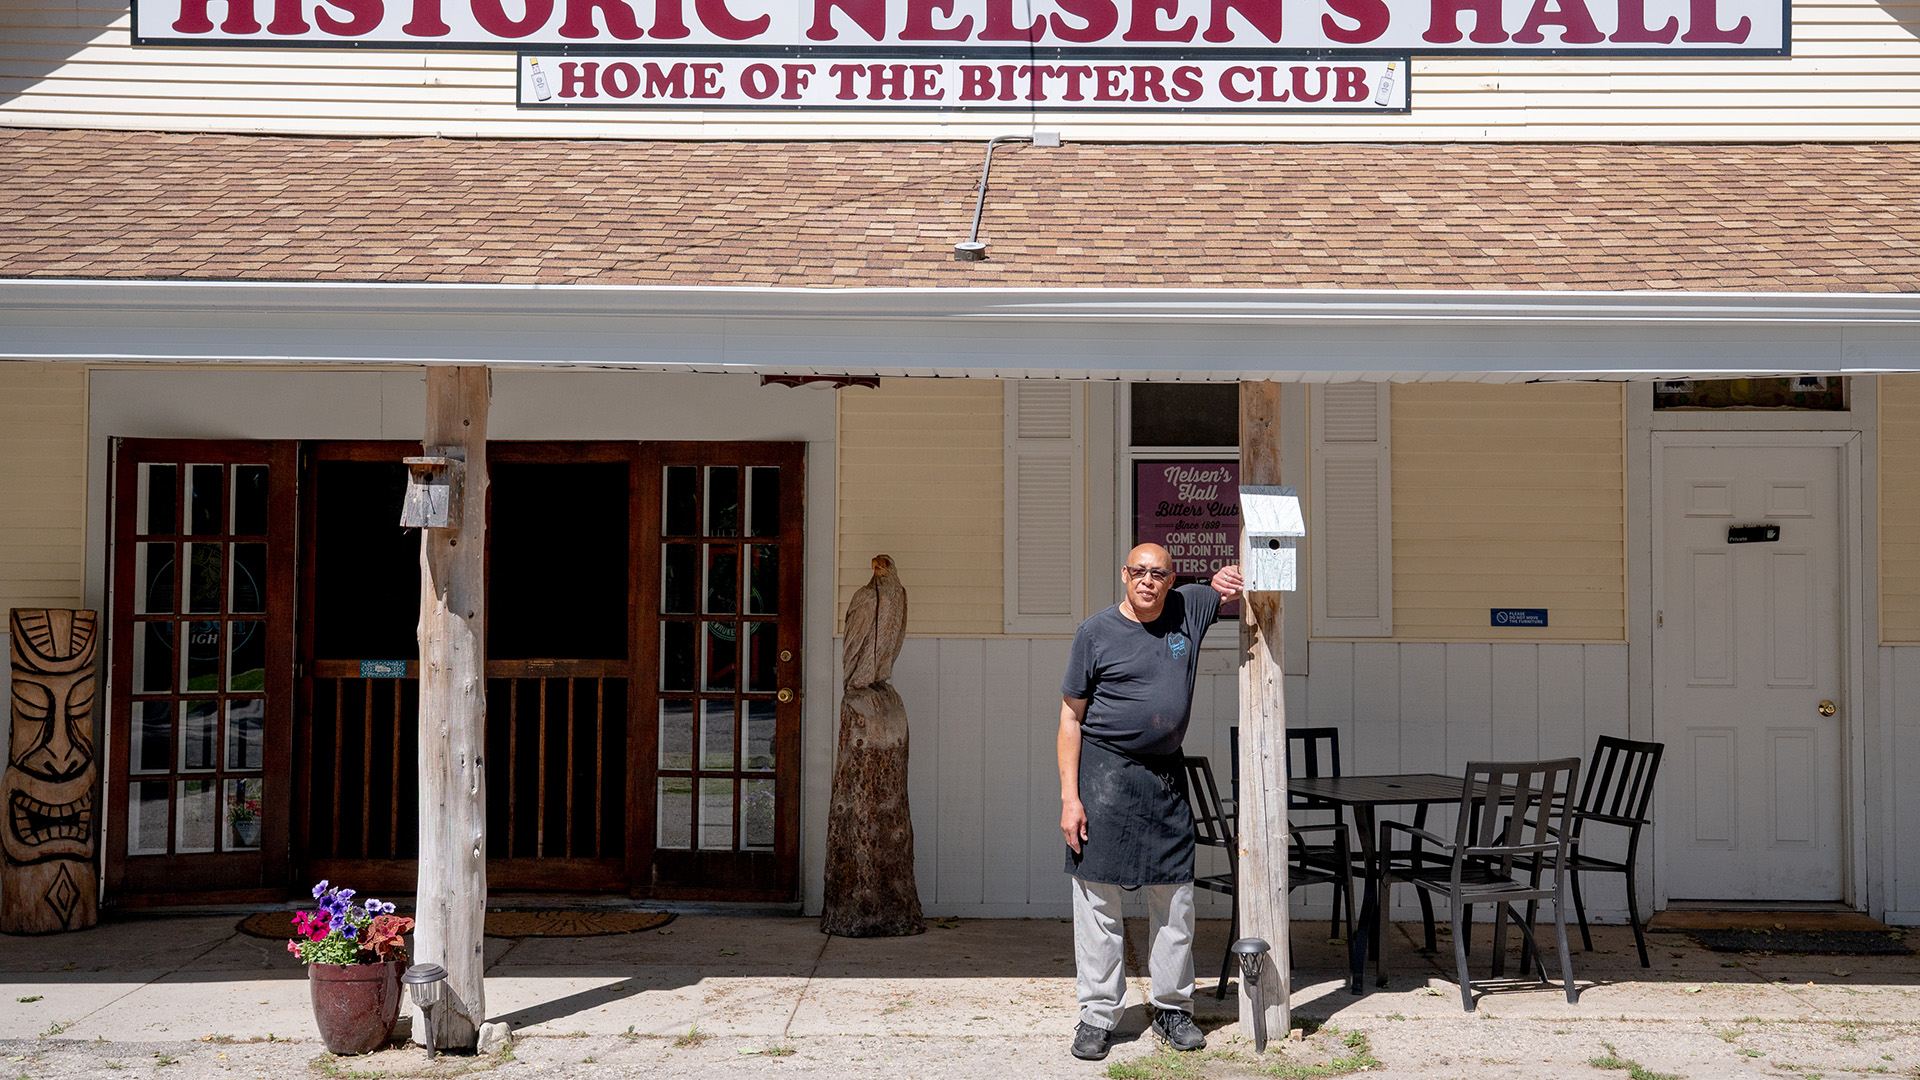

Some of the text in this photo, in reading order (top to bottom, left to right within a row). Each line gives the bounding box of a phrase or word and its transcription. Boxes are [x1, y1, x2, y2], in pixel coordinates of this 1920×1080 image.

[805, 0, 1390, 43] NELSENS
[1421, 0, 1752, 44] HALL
[557, 61, 1370, 103] HOME OF THE BITTERS CLUB
[1163, 466, 1232, 487] Nelsen's
[1178, 483, 1218, 503] Hall
[1155, 501, 1239, 517] Bitters Club
[1175, 520, 1221, 530] Since 1899
[1165, 532, 1227, 544] COME ON IN
[1186, 545, 1212, 556] JOIN
[1213, 545, 1234, 556] THE
